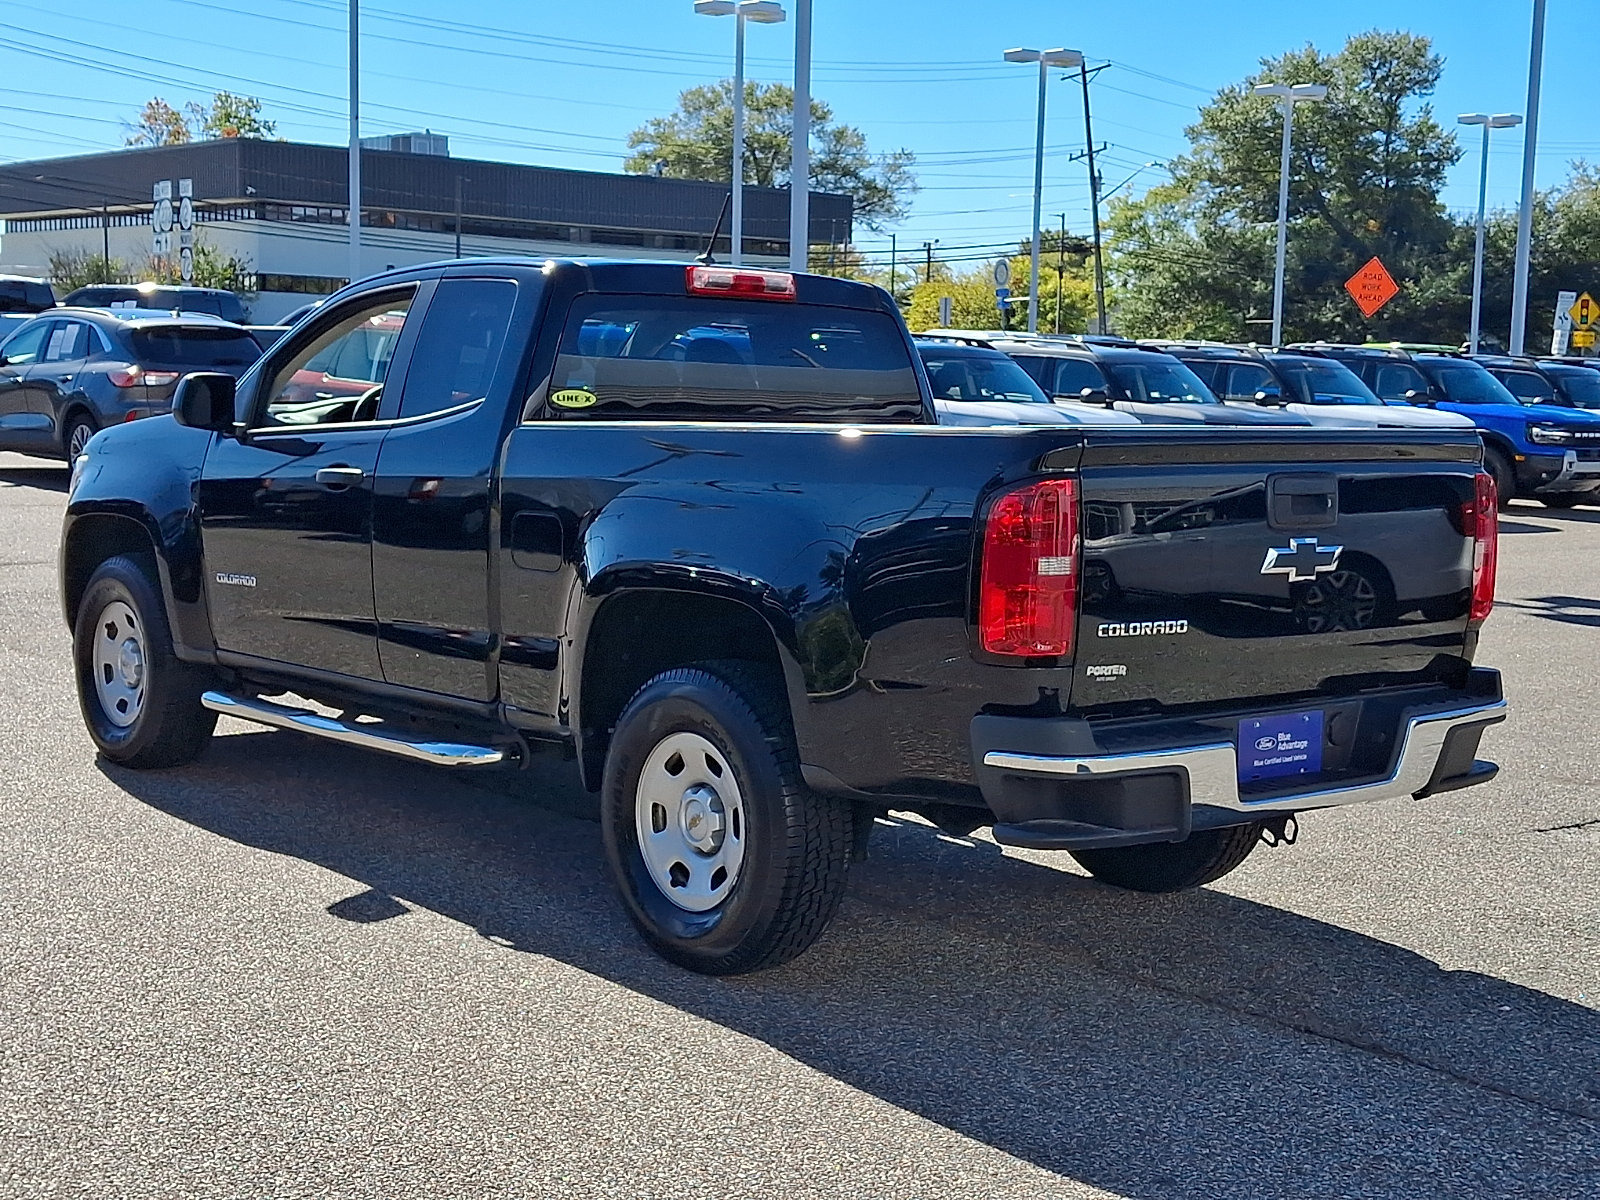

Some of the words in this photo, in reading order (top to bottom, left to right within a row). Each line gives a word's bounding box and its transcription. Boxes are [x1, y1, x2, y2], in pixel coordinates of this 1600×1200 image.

[1363, 272, 1383, 281] ROAD
[1359, 293, 1383, 302] AHEAD
[556, 394, 592, 403] LINE-X
[216, 572, 257, 587] COLORADO
[1098, 619, 1188, 637] COLORADO
[1086, 664, 1127, 676] PORTER
[1277, 732, 1291, 742] Blue
[1277, 740, 1308, 751] Advantage
